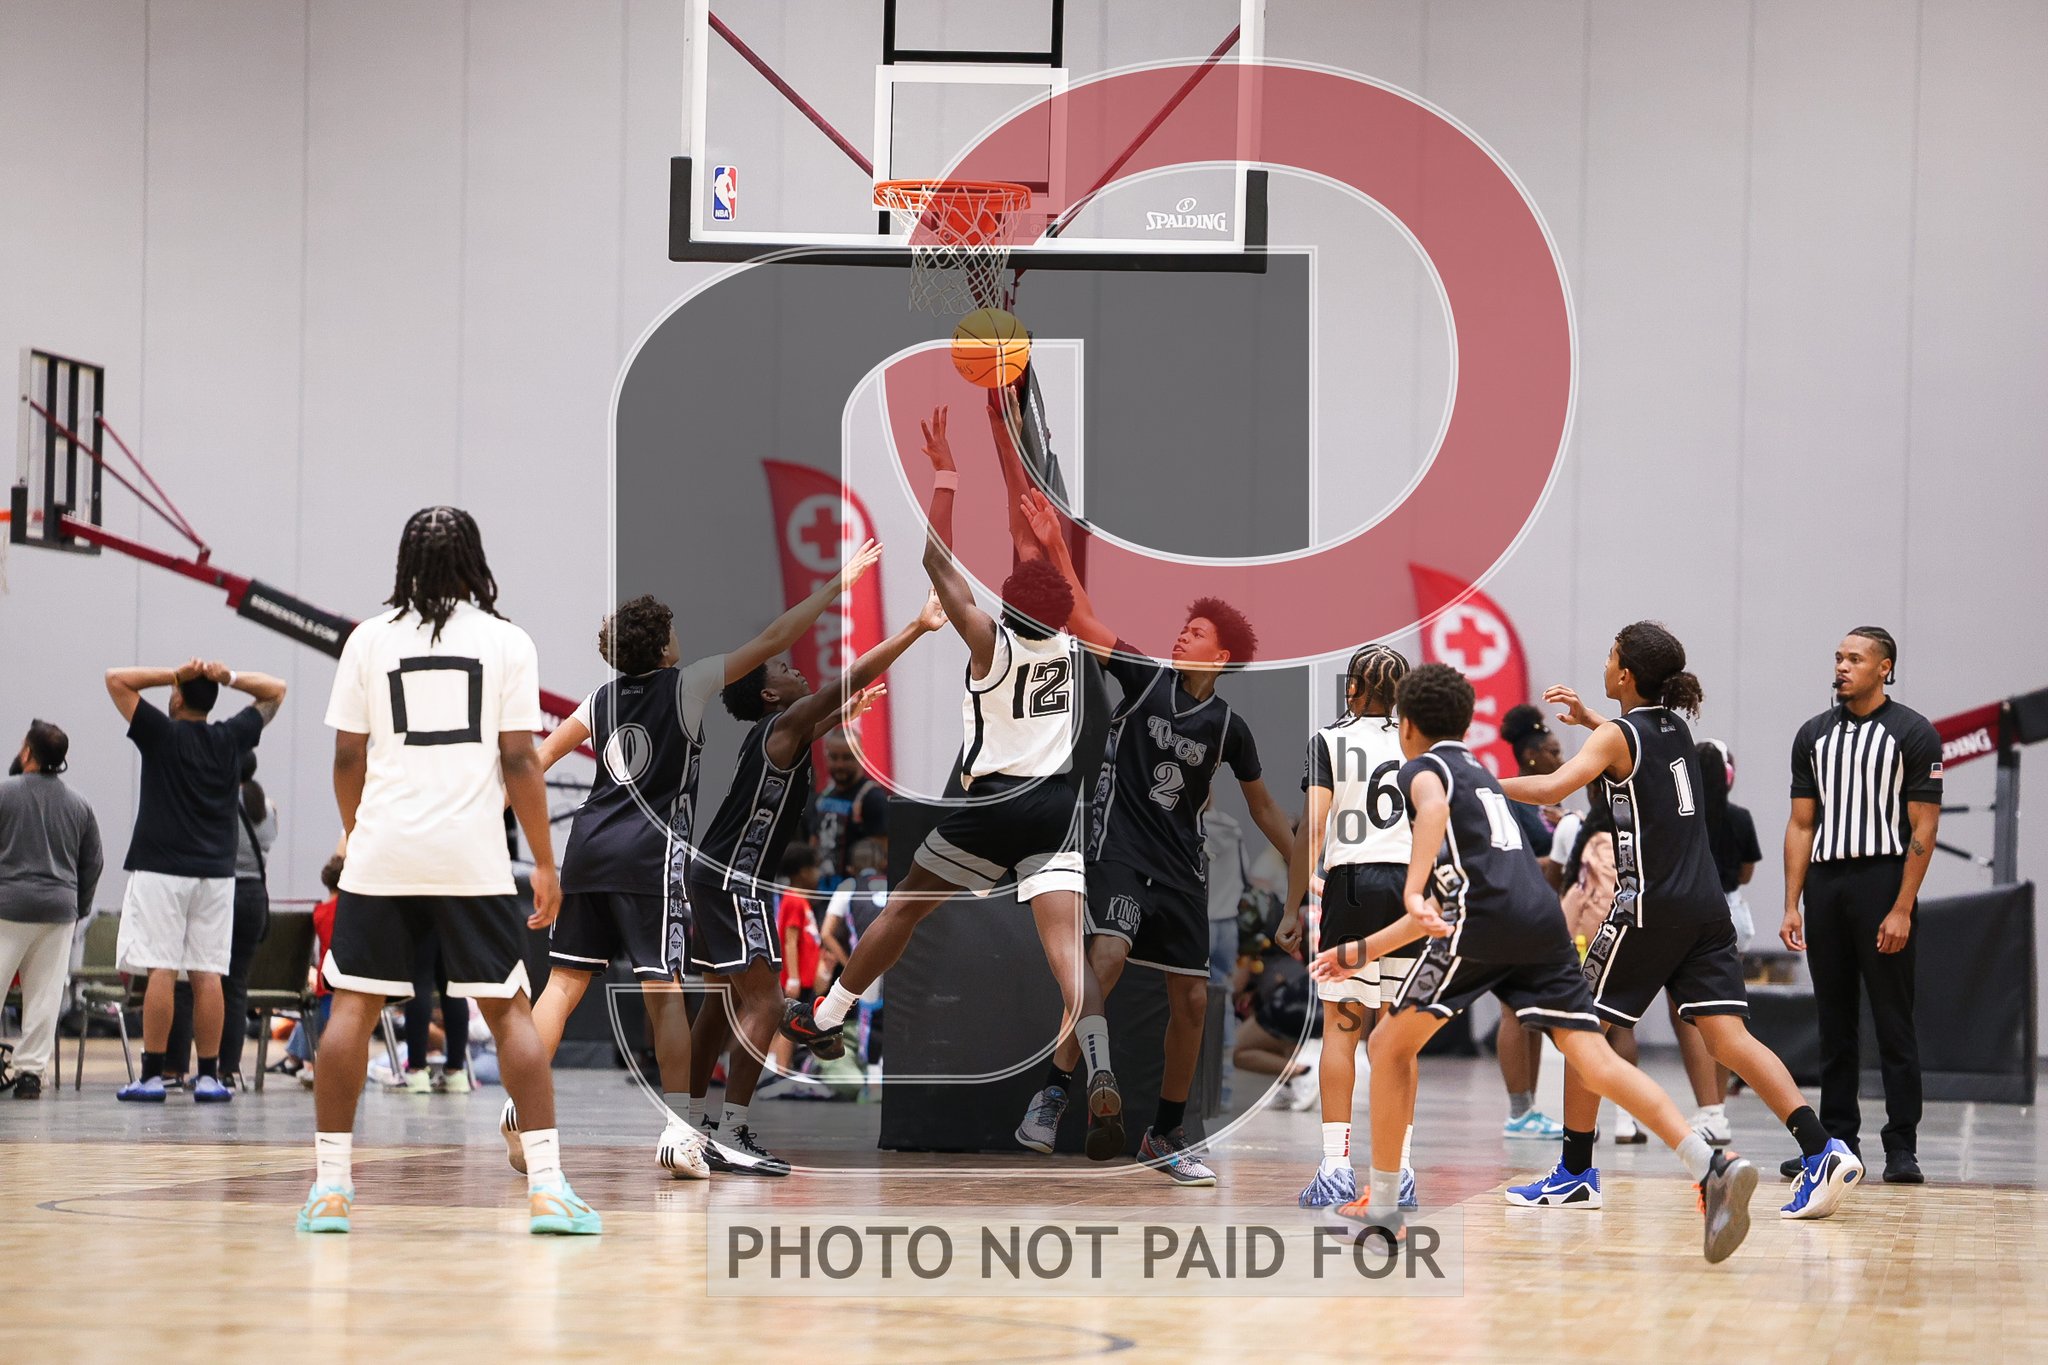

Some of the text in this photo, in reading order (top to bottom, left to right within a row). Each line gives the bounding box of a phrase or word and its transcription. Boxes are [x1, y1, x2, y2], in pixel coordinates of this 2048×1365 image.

[1145, 211, 1229, 232] SPALDING
[1012, 656, 1070, 720] 12
[603, 722, 653, 786] 0
[1942, 727, 1993, 762] DING
[1148, 761, 1186, 812] 2
[1366, 760, 1405, 830] 6
[1669, 757, 1696, 817] 1
